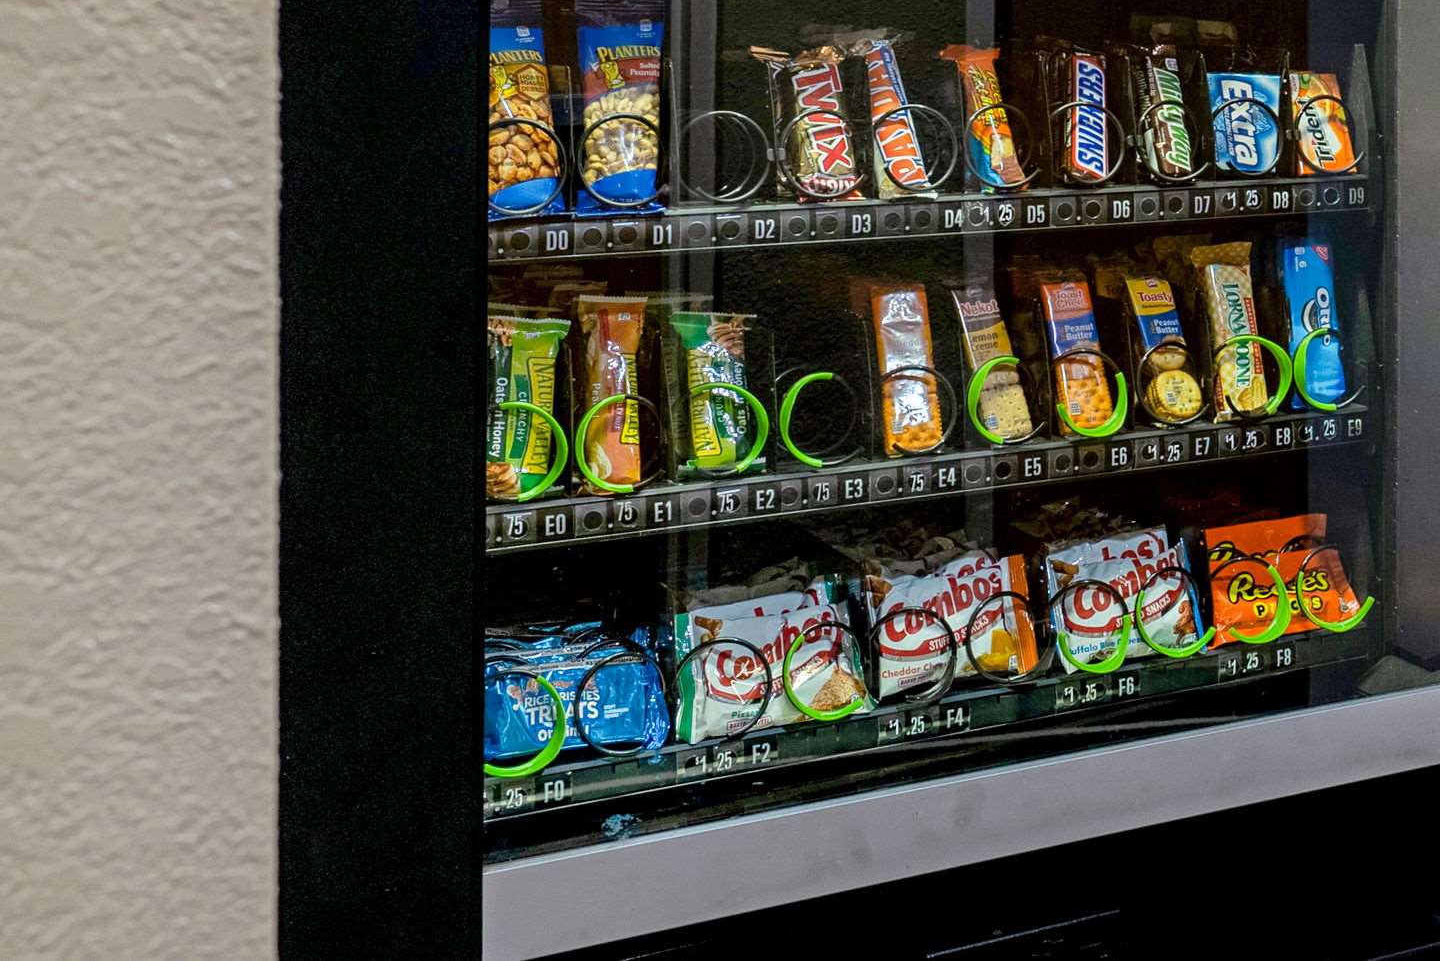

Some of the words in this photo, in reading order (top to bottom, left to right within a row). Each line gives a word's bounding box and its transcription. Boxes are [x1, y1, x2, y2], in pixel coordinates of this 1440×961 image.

[596, 45, 661, 62] PLANTERS
[1078, 61, 1105, 176] SNICKERS
[1221, 79, 1257, 166] Extra
[1194, 196, 1211, 215] D7
[1273, 191, 1290, 209] D8
[1349, 187, 1365, 205] D9
[945, 209, 963, 228] D4
[1027, 205, 1046, 224] D5
[1113, 200, 1131, 219] D6
[754, 218, 776, 238] D2
[852, 214, 872, 233] D3
[546, 231, 568, 251] D0
[653, 224, 673, 245] D1
[1137, 291, 1172, 303] Toasty
[1065, 323, 1094, 333] Peanut
[1153, 318, 1179, 327] Peanut
[1066, 332, 1092, 341] Butter
[1276, 427, 1291, 446] E8
[1347, 418, 1362, 436] E9
[489, 420, 506, 458] Honey
[1195, 438, 1210, 455] E7
[1024, 457, 1041, 476] E5
[1111, 448, 1127, 466] E6
[938, 468, 957, 488] E4
[845, 478, 863, 500] E3
[756, 489, 775, 510] E2
[654, 501, 672, 523] E1
[545, 513, 567, 536] E0
[884, 572, 1001, 642] Combos
[1146, 593, 1170, 615] SNACKS
[1276, 648, 1292, 668] F8
[881, 666, 921, 679] Cheddar
[1118, 676, 1135, 697] F6
[524, 694, 549, 707] RICE
[526, 703, 599, 725] TRATS
[946, 707, 964, 728] F4
[752, 742, 771, 764] F2
[543, 781, 565, 803] F0
